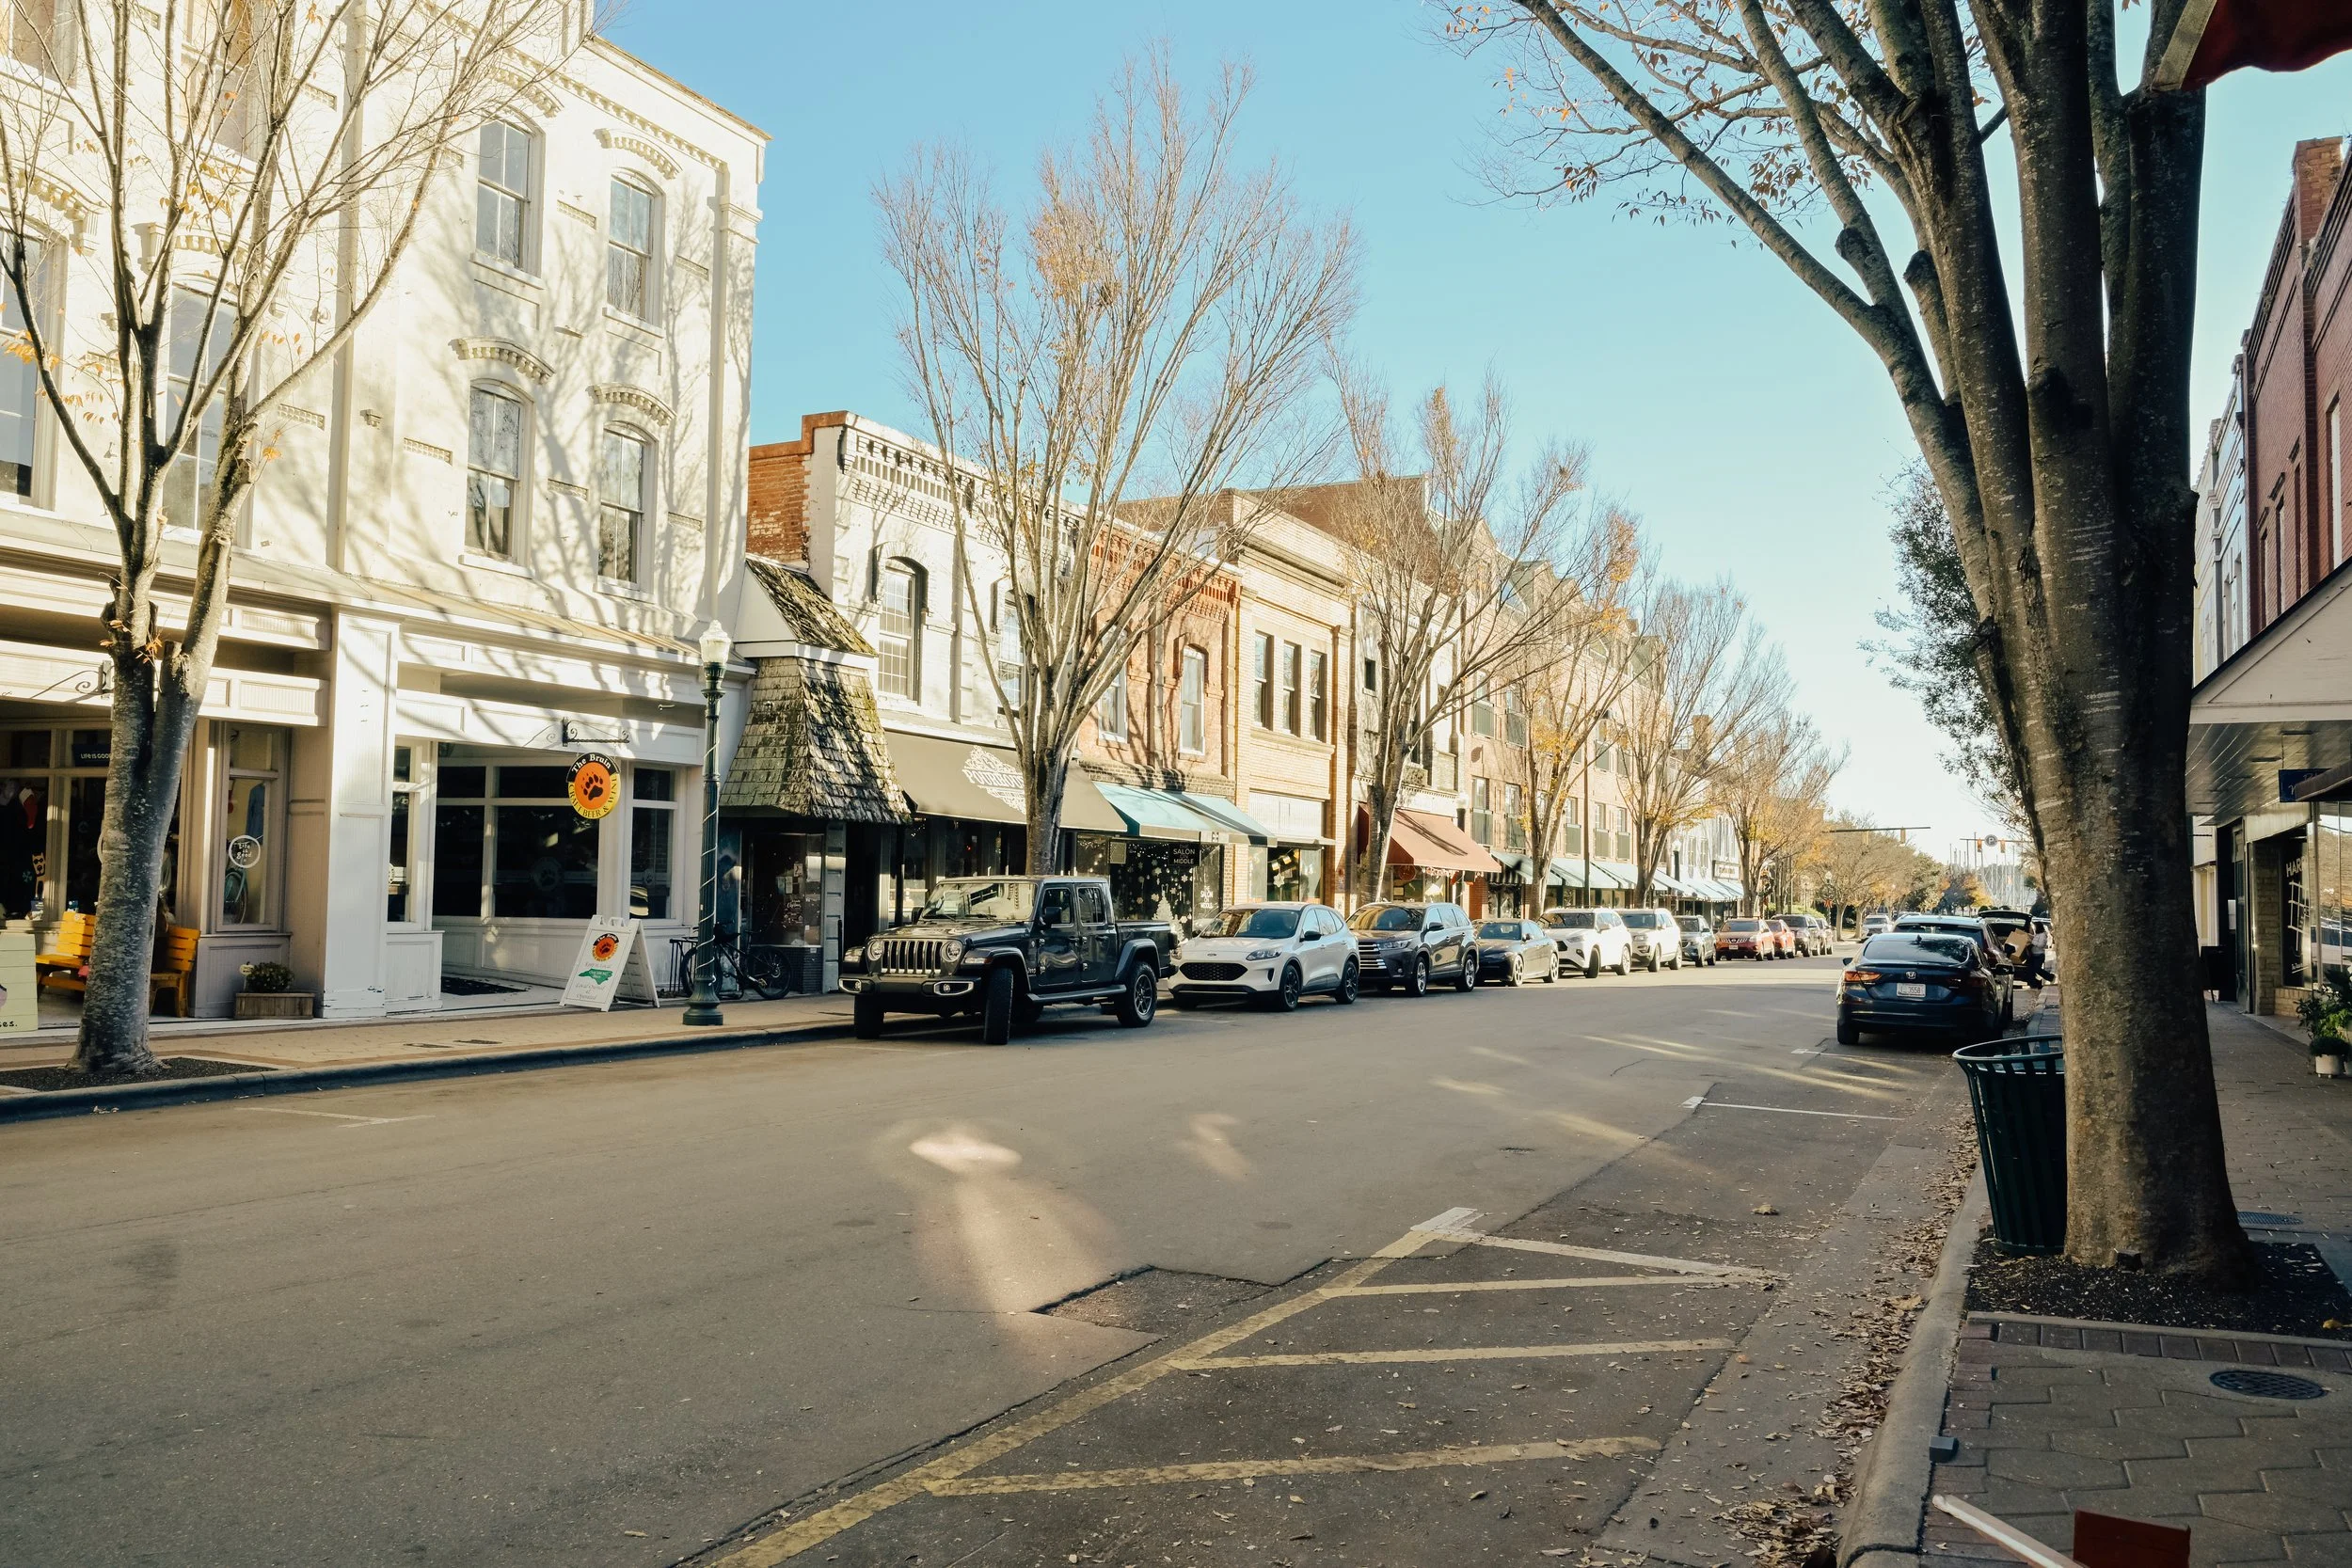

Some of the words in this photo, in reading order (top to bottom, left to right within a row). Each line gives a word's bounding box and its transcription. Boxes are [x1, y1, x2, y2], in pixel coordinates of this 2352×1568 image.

[571, 758, 587, 772] The
[589, 753, 612, 768] Bruin
[568, 784, 582, 812] CRAFT
[582, 809, 602, 818] BEER
